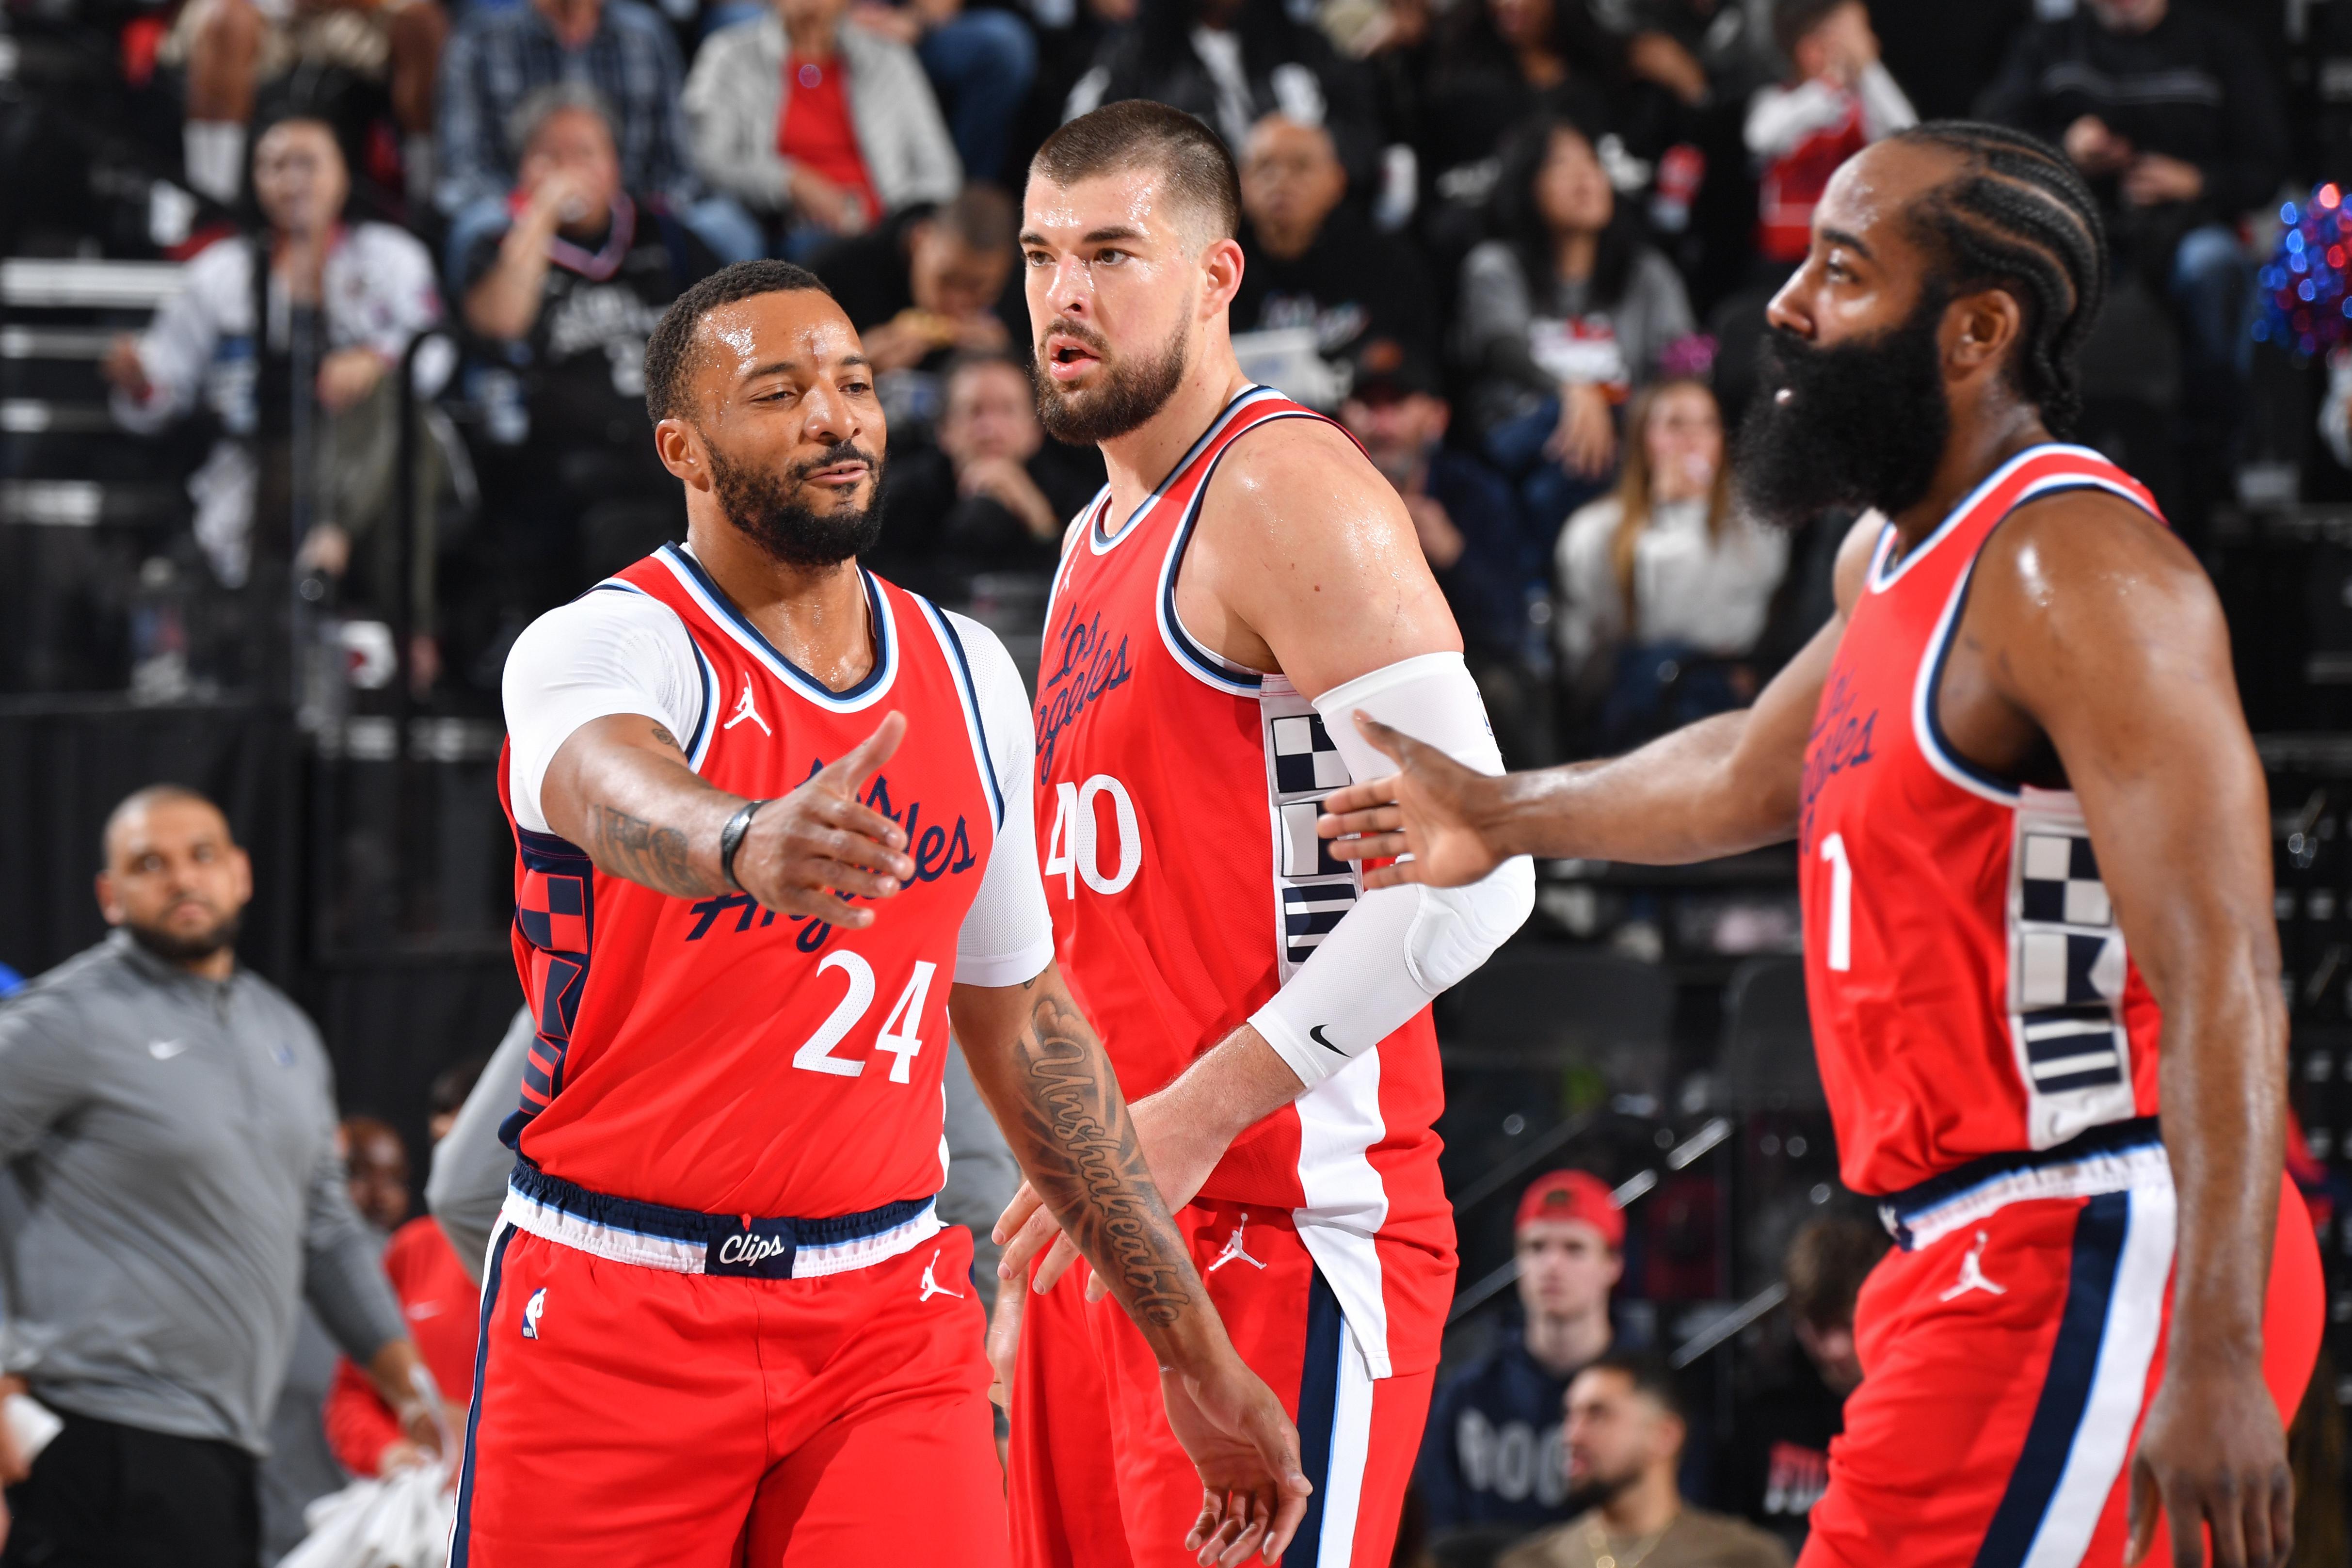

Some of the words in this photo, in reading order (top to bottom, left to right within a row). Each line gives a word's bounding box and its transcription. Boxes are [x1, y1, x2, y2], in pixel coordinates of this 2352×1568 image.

[1036, 630, 1133, 786] geles
[1045, 774, 1142, 900] 40
[1820, 831, 1852, 972] 1
[792, 949, 937, 1084] 24
[719, 1233, 784, 1267] Clips
